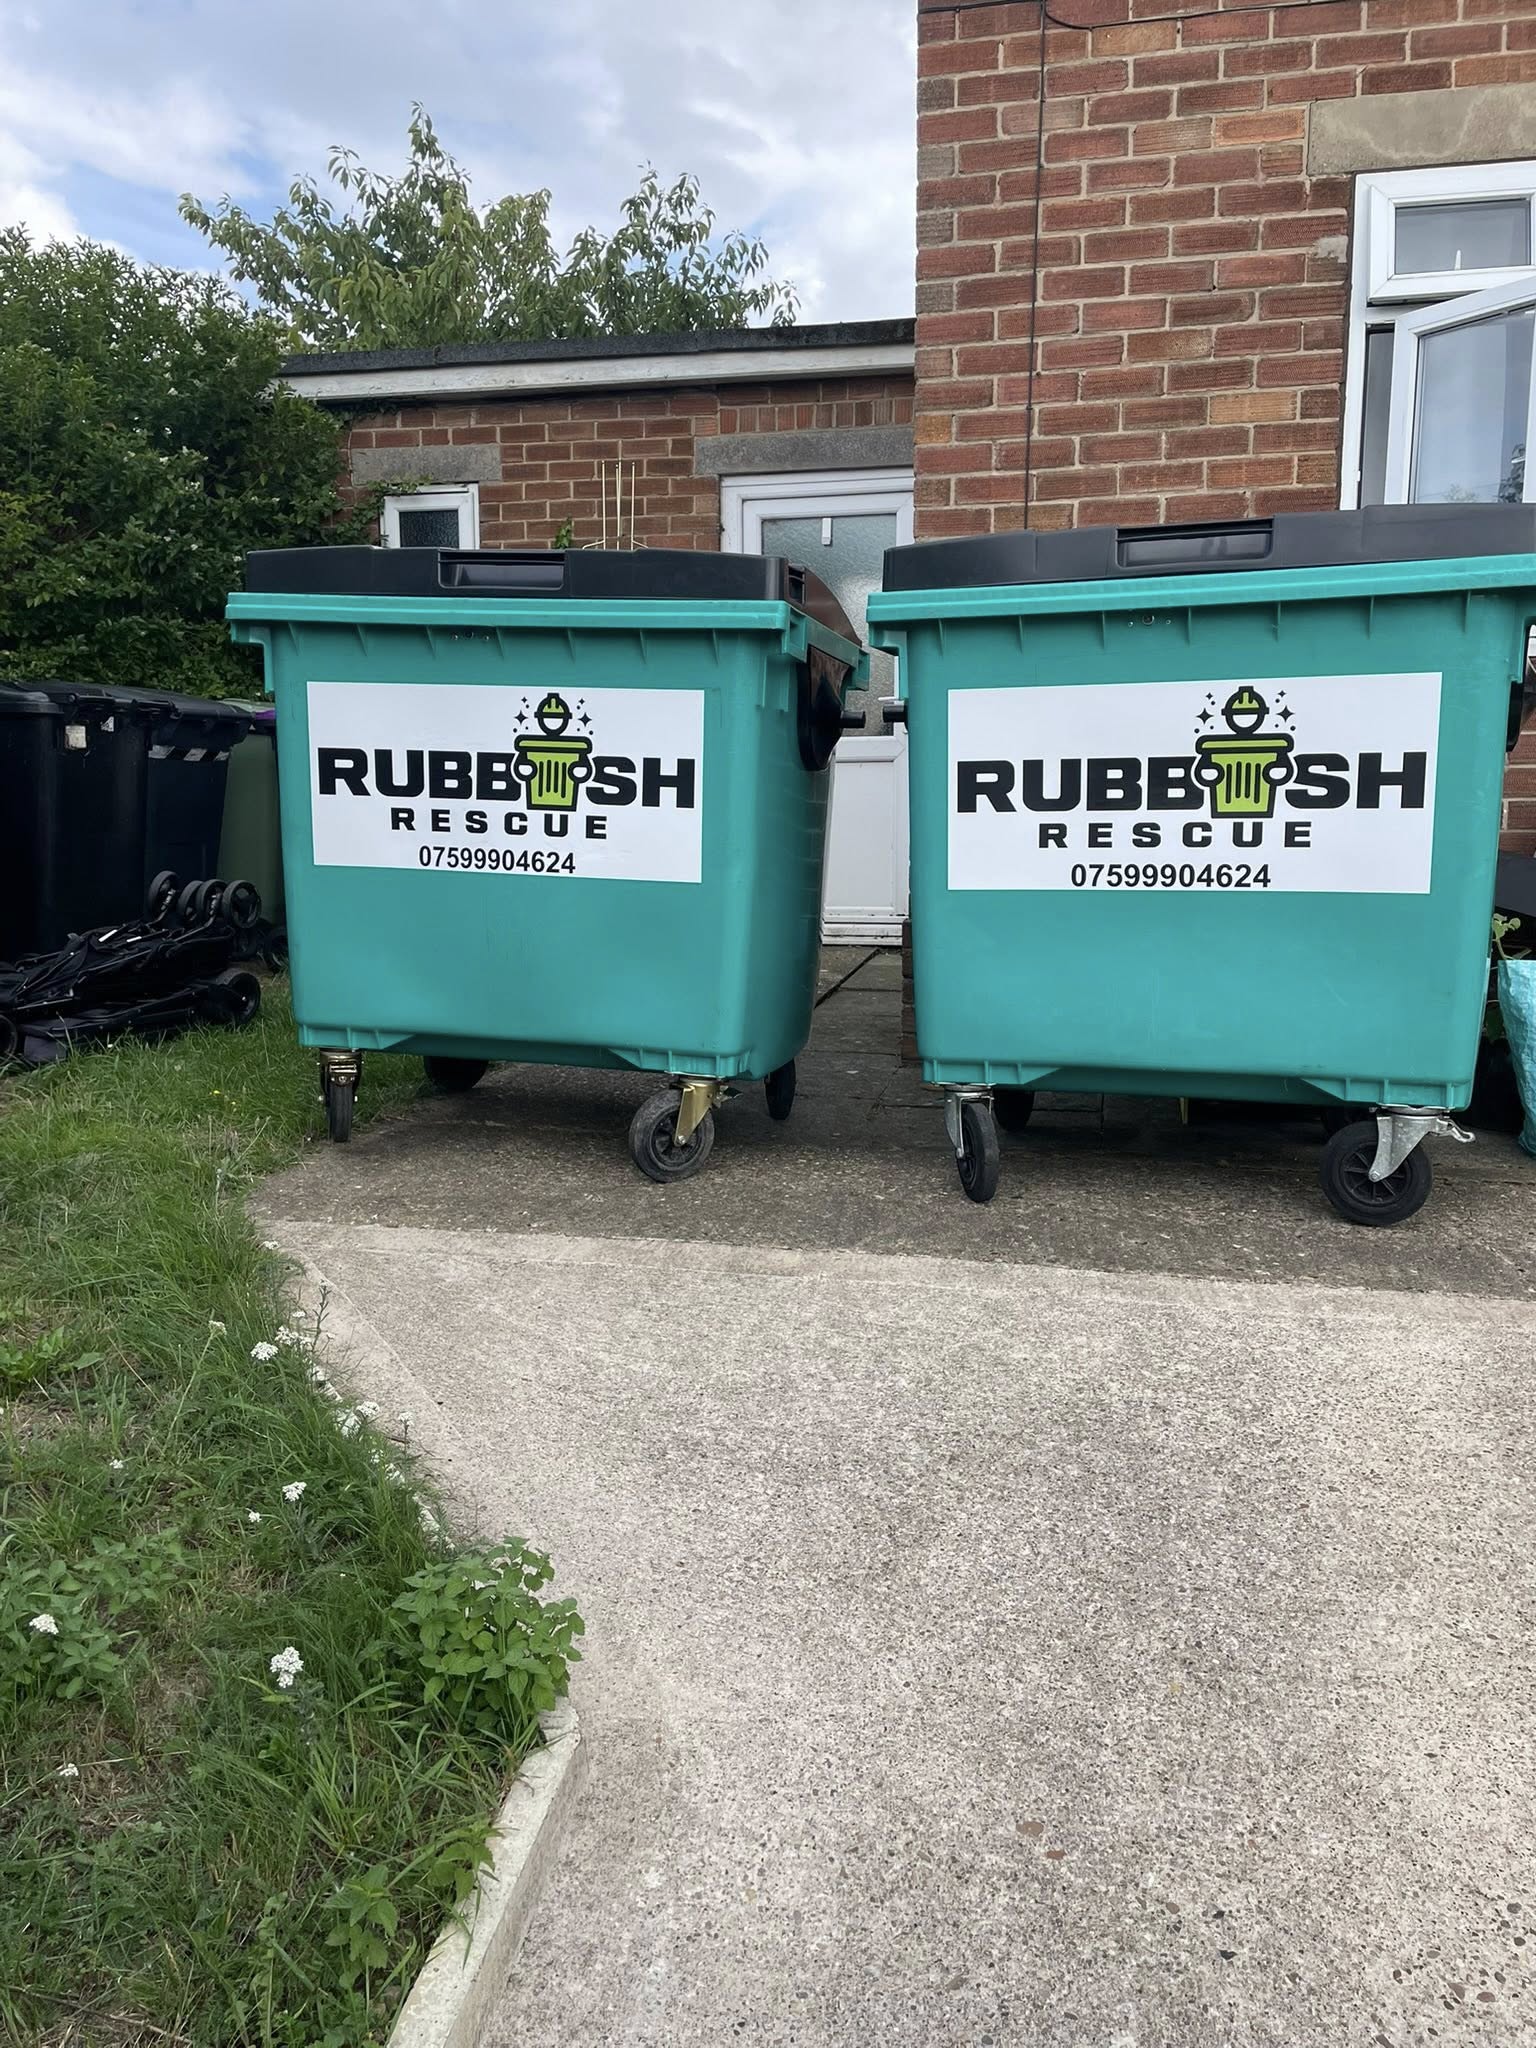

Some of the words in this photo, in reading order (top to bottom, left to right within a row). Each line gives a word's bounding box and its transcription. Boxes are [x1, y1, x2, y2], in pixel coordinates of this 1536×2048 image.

[317, 747, 696, 810] RUBBSH
[957, 751, 1427, 814] RUBBSH
[390, 807, 608, 840] RESCUE
[1038, 821, 1312, 849] RESCUE
[419, 845, 574, 874] 07599904624
[1071, 863, 1271, 888] 07599904624
